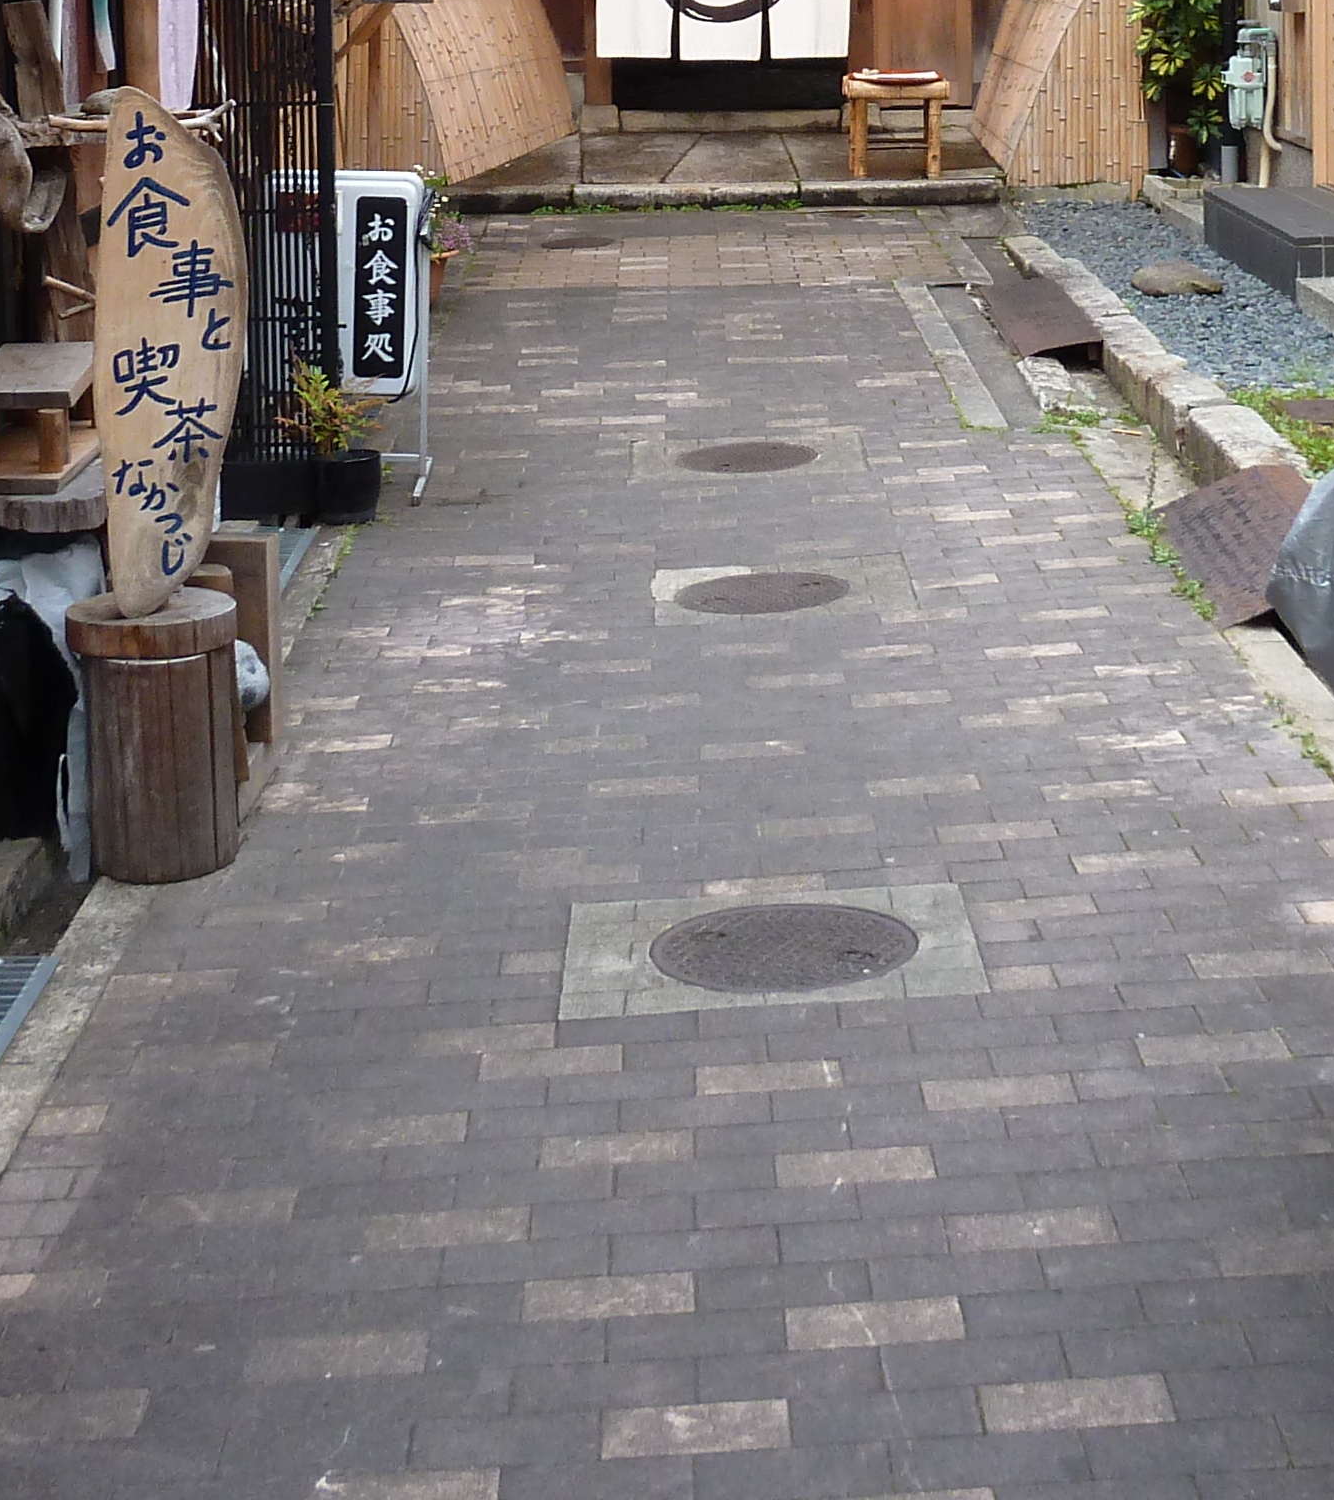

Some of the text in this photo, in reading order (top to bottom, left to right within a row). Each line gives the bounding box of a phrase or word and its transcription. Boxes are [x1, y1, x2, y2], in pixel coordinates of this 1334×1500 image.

[361, 213, 399, 363] お食事処
[112, 458, 193, 576] なかつじ
